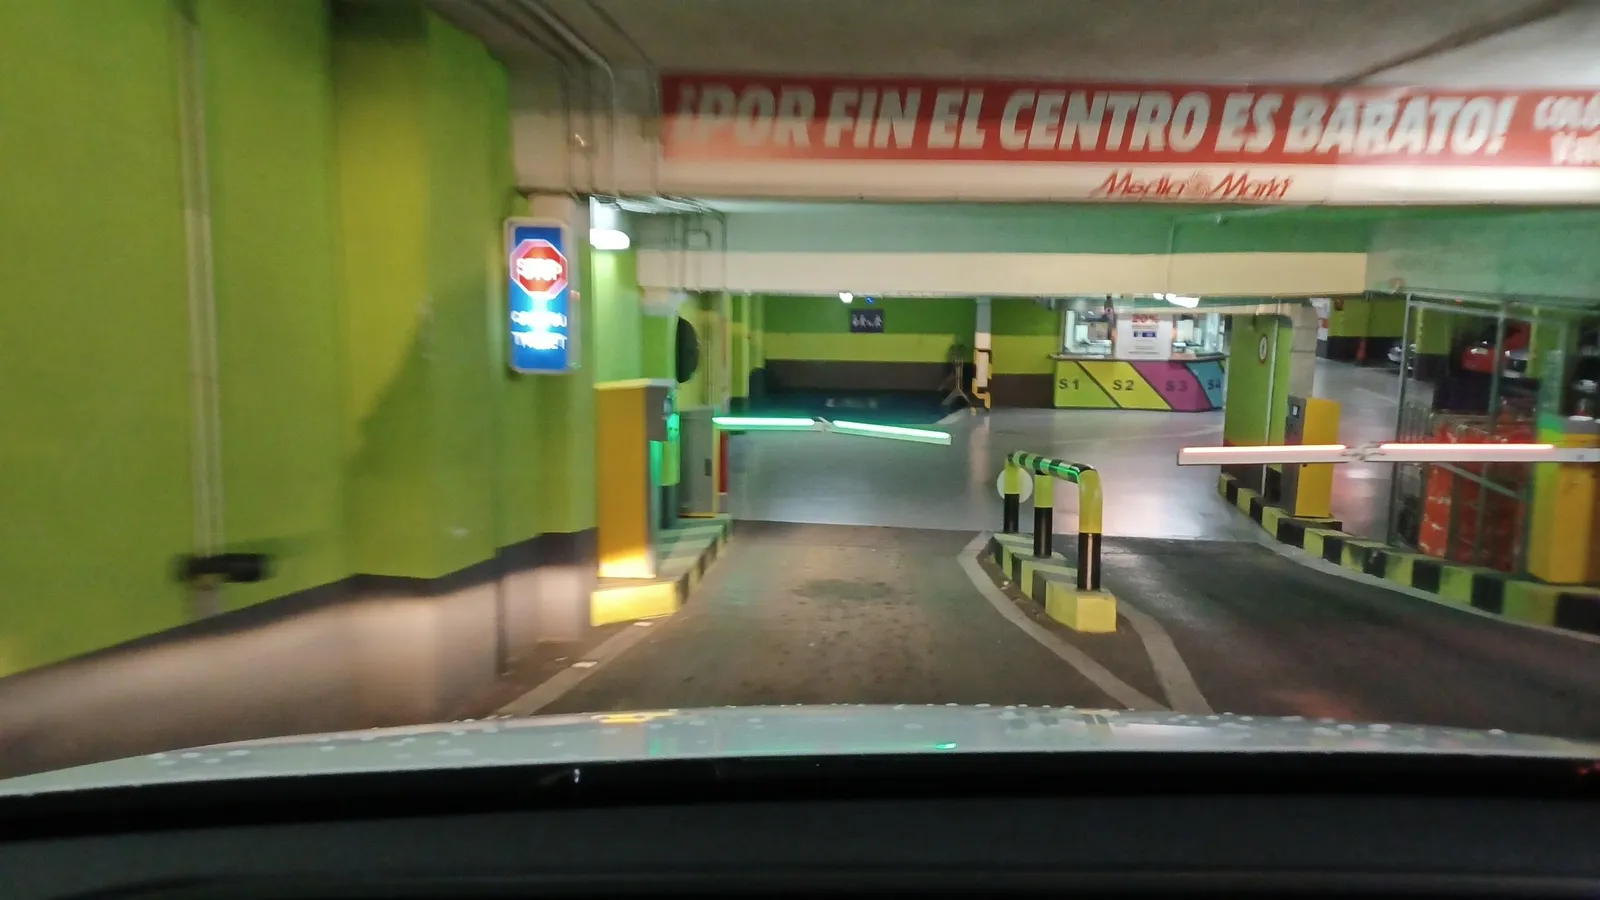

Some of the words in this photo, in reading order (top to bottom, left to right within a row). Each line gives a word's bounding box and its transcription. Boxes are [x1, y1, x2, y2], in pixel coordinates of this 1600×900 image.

[822, 85, 922, 150] FIN
[926, 88, 986, 152] EL
[999, 88, 1212, 154] CENTRO
[1213, 91, 1283, 154] ES
[1281, 93, 1519, 157] BARATO!
